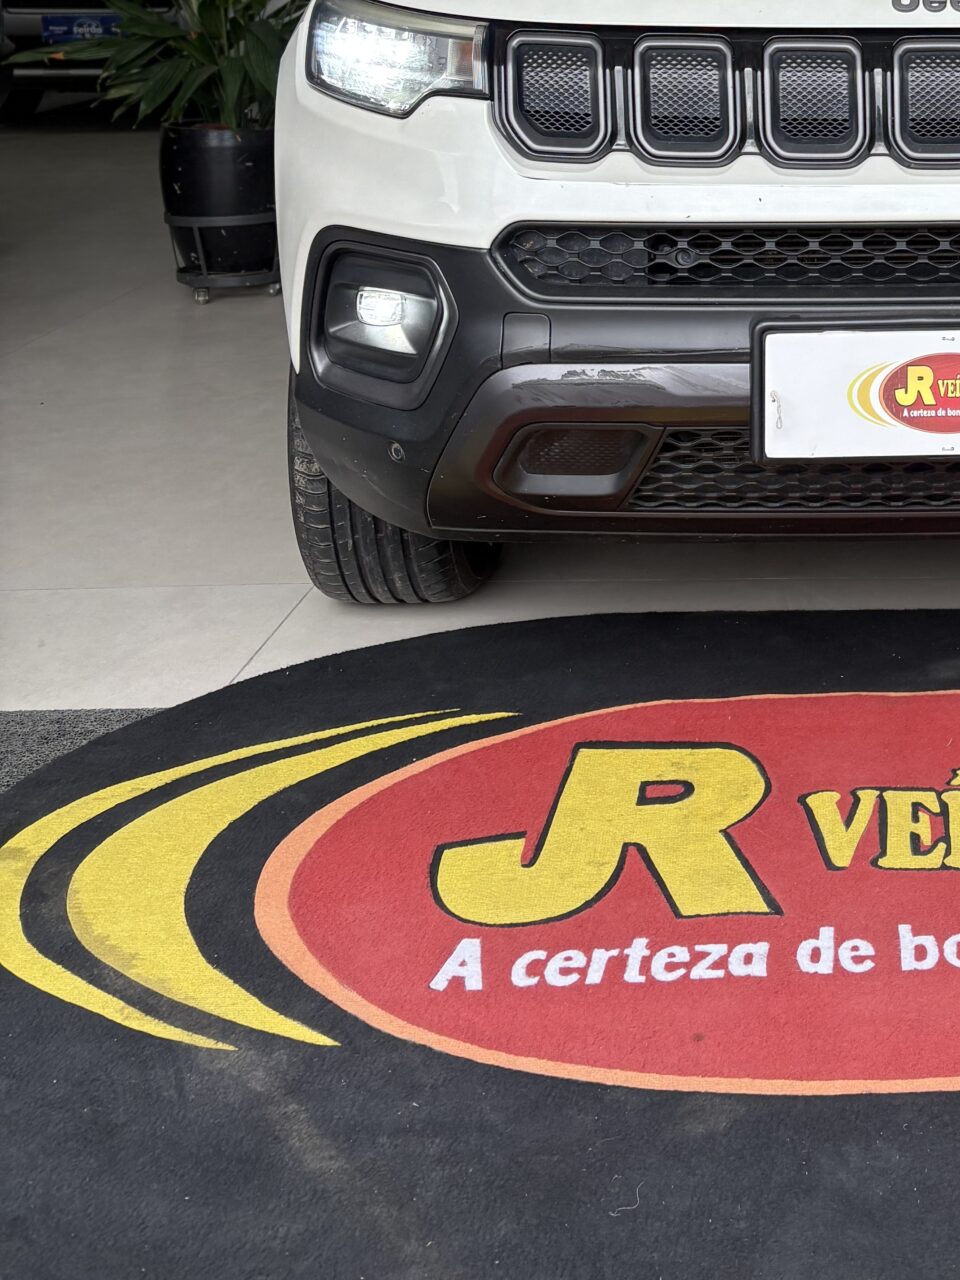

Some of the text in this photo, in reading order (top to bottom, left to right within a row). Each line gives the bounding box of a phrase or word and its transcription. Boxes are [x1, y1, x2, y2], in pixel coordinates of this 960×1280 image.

[894, 364, 937, 407] JR
[903, 408, 909, 417] A
[909, 407, 936, 417] certeza
[936, 407, 946, 417] de
[429, 740, 783, 929] JR
[429, 937, 483, 992] A
[510, 937, 770, 988] certeza
[795, 926, 876, 975] de
